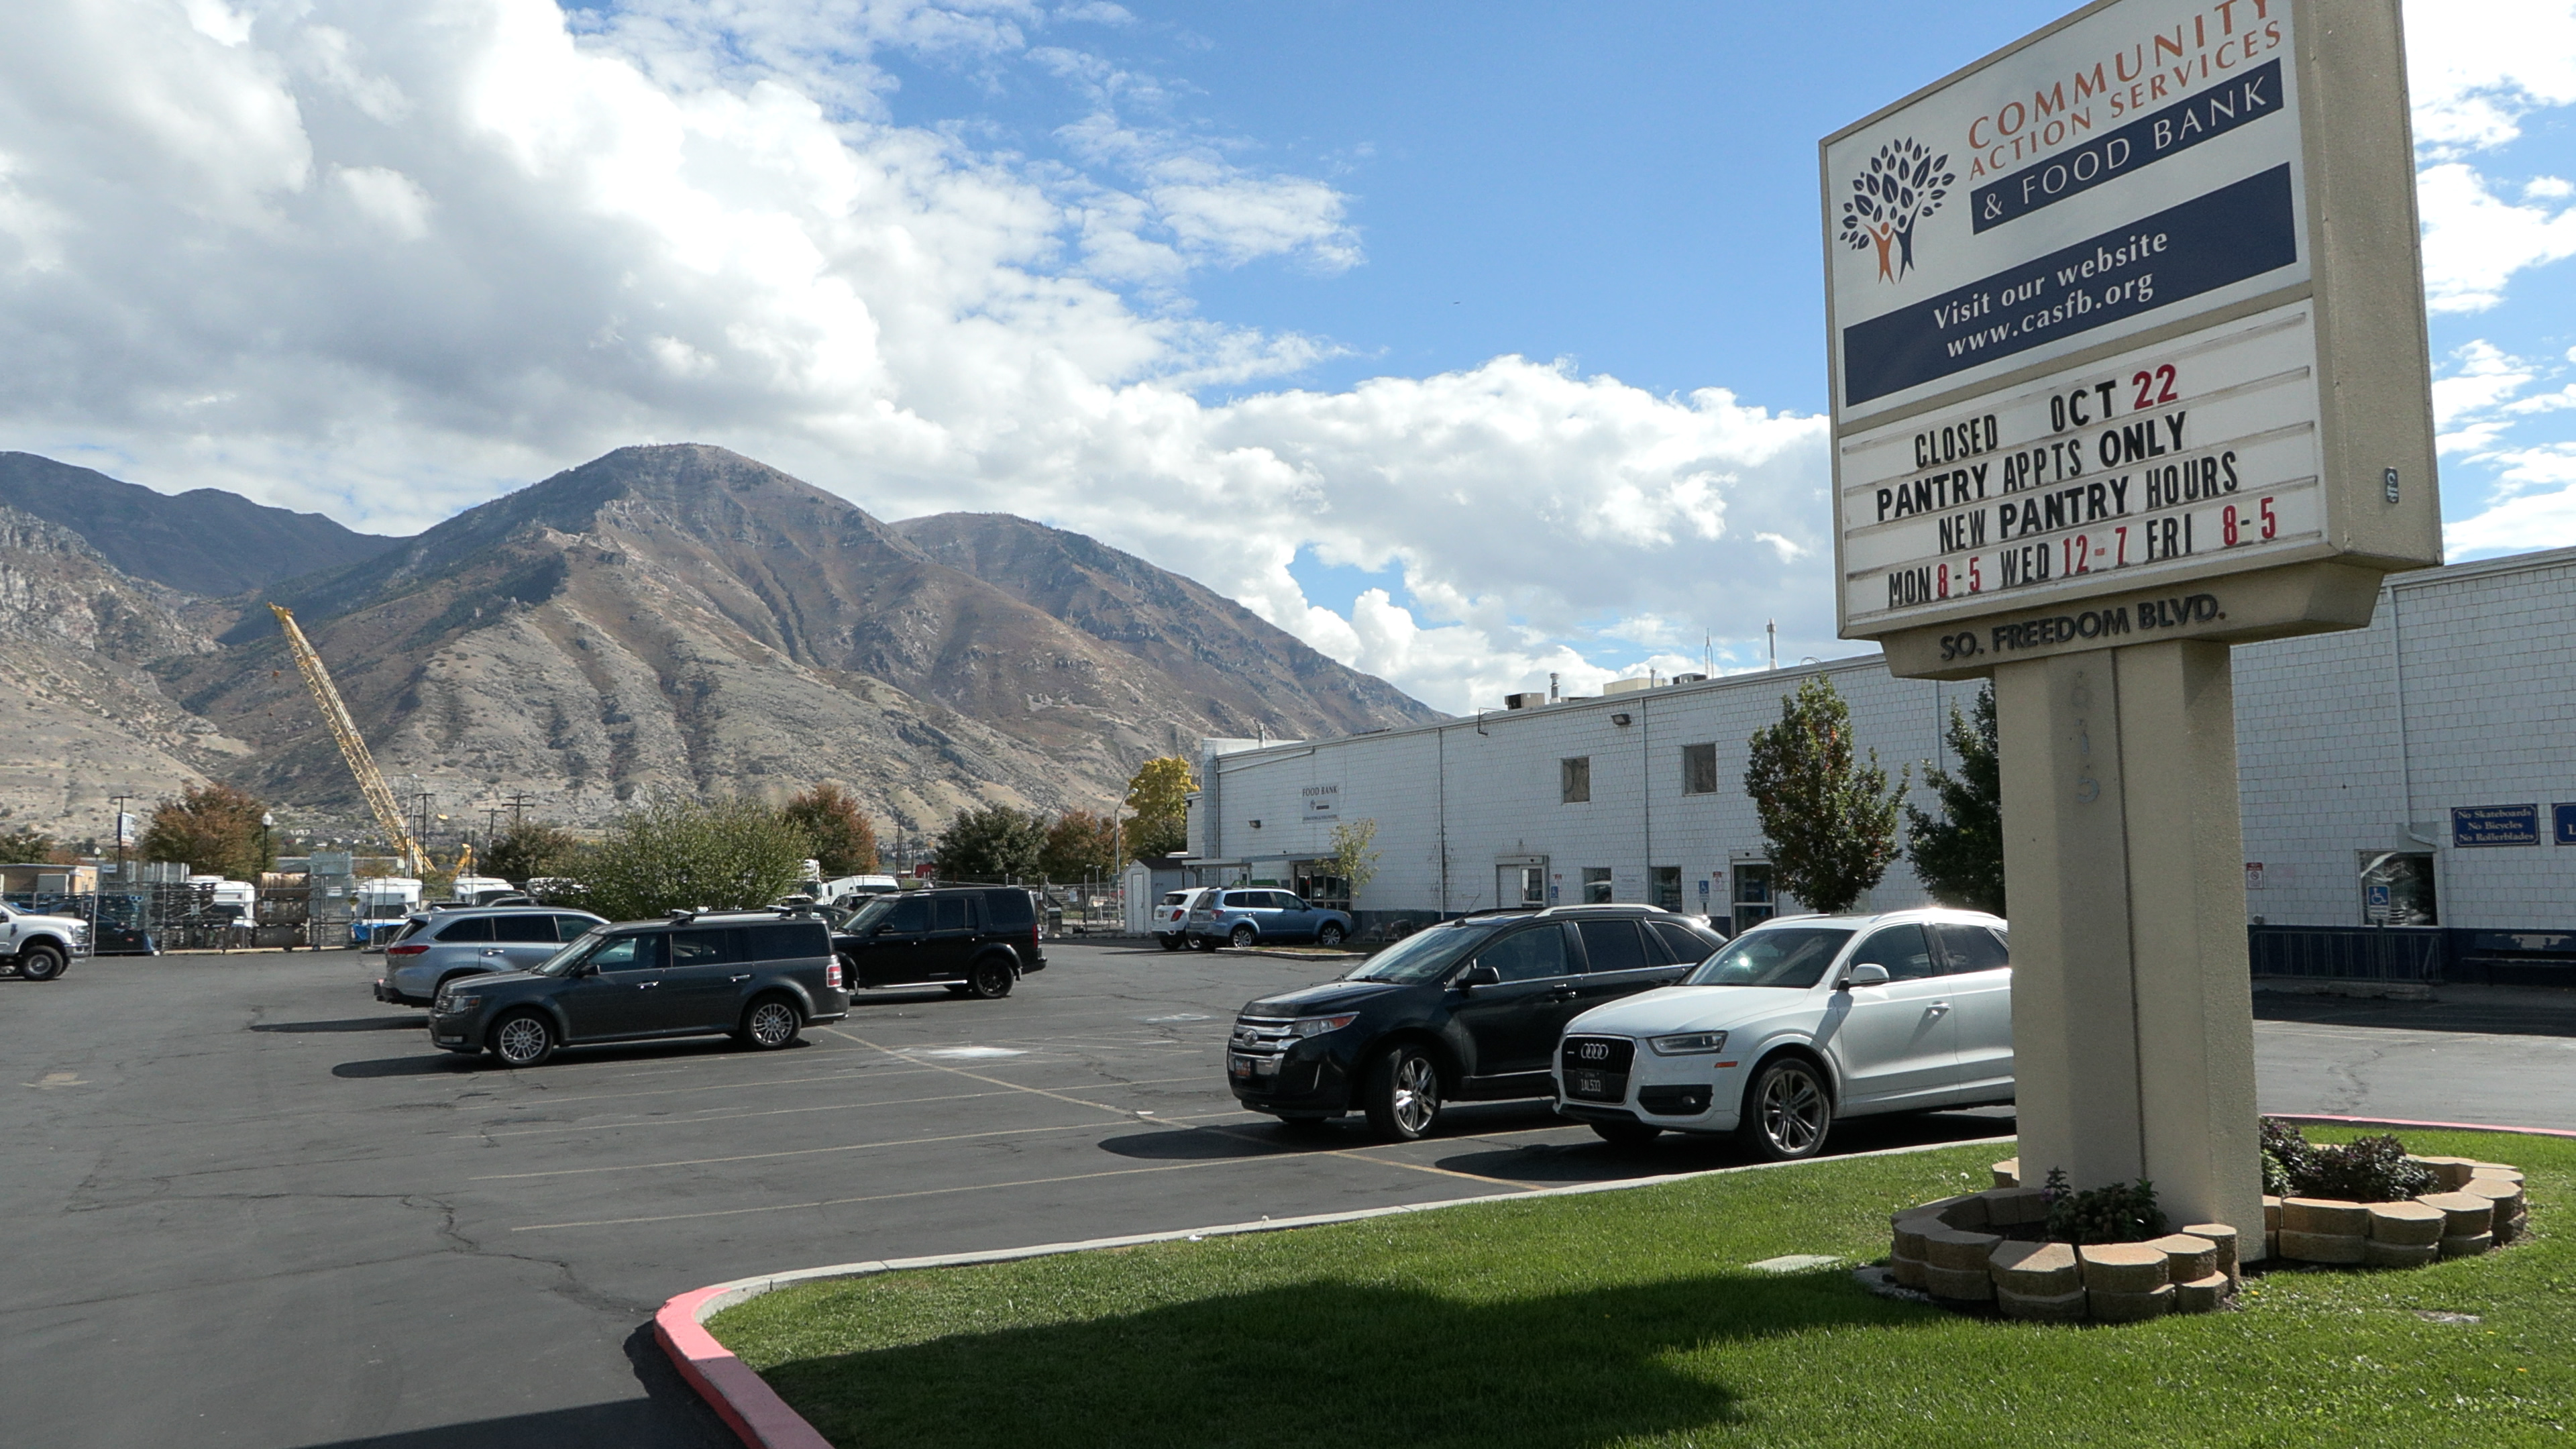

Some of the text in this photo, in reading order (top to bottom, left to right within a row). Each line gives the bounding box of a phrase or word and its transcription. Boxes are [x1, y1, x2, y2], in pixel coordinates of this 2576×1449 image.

[1968, 0, 2267, 150] COMMUNITY
[1969, 20, 2281, 180] ACTION SERVICES
[1984, 76, 2267, 220] & FOOD BANK
[1933, 232, 2168, 329] Visit our website
[1947, 272, 2155, 358] www.casfb.org
[1915, 364, 2178, 469] CLOSED OCT 22
[1877, 411, 2187, 522] PANTRY APPTS ONLY
[1939, 451, 2238, 554] NEW PANTRY HOURS
[1888, 566, 1931, 608] MON
[2000, 542, 2050, 587] WED
[2147, 513, 2192, 559] FRI
[1940, 593, 2226, 661] SO. FREEDOM BLVD.
[1303, 786, 1338, 796] FOOD BANK
[2458, 808, 2532, 818] No Skateboards
[2459, 832, 2534, 842] No Rollerblades
[2468, 820, 2524, 830] No Bicycles
